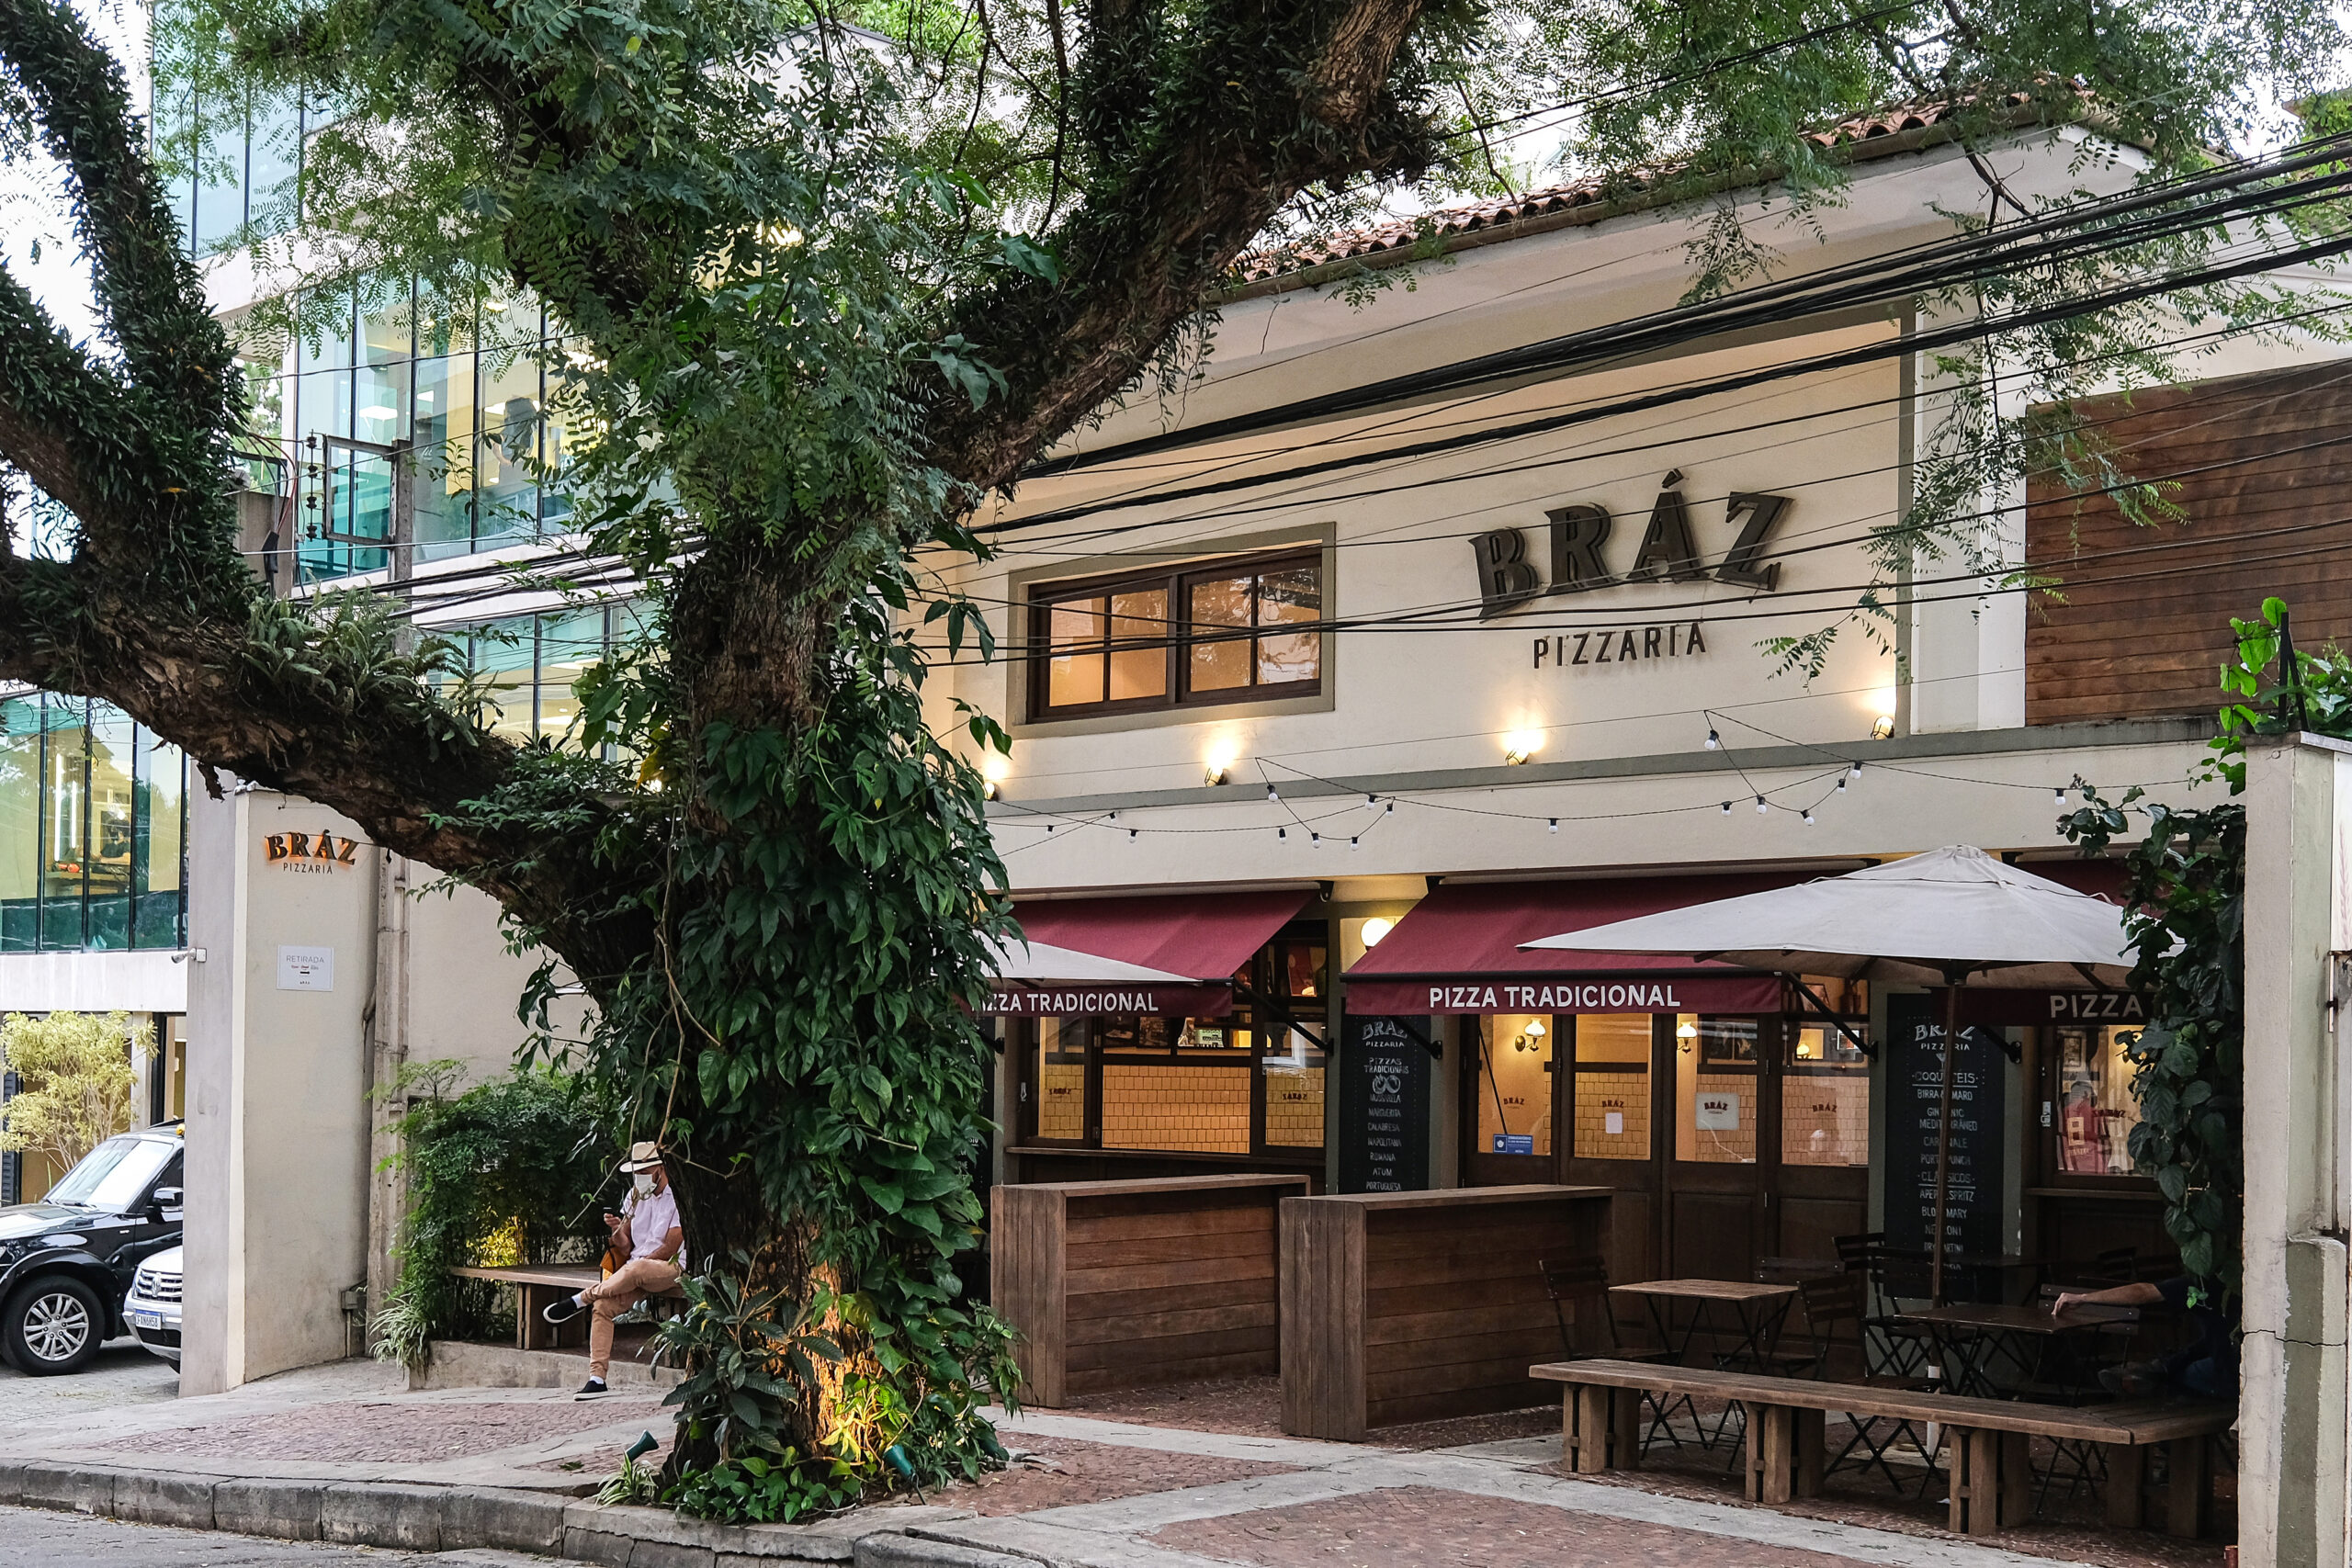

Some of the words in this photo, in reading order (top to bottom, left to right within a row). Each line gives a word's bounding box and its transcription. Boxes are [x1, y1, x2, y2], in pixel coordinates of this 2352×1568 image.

[1468, 468, 1793, 623] BRÁZ
[1532, 623, 1707, 669] PIZZARIA
[267, 829, 359, 865] BRÁZ
[283, 863, 333, 874] PIZZARIA
[286, 954, 324, 964] RETIRADA
[1430, 987, 1498, 1008] PIZZA
[1503, 984, 1681, 1008] TRADICIONAL
[1026, 992, 1159, 1012] TRADICIONAL
[2050, 994, 2144, 1019] PIZZA
[1368, 1057, 1403, 1066] PIZZAS
[1917, 1089, 1939, 1099] BIRRA
[1367, 1122, 1400, 1132] CALABRESA
[1370, 1152, 1396, 1162] ROMANA
[1373, 1168, 1392, 1177] ATUM
[1366, 1181, 1402, 1191] PORTUGUESA
[1948, 1190, 1974, 1202] SPRITZ
[1946, 1207, 1968, 1219] MARY
